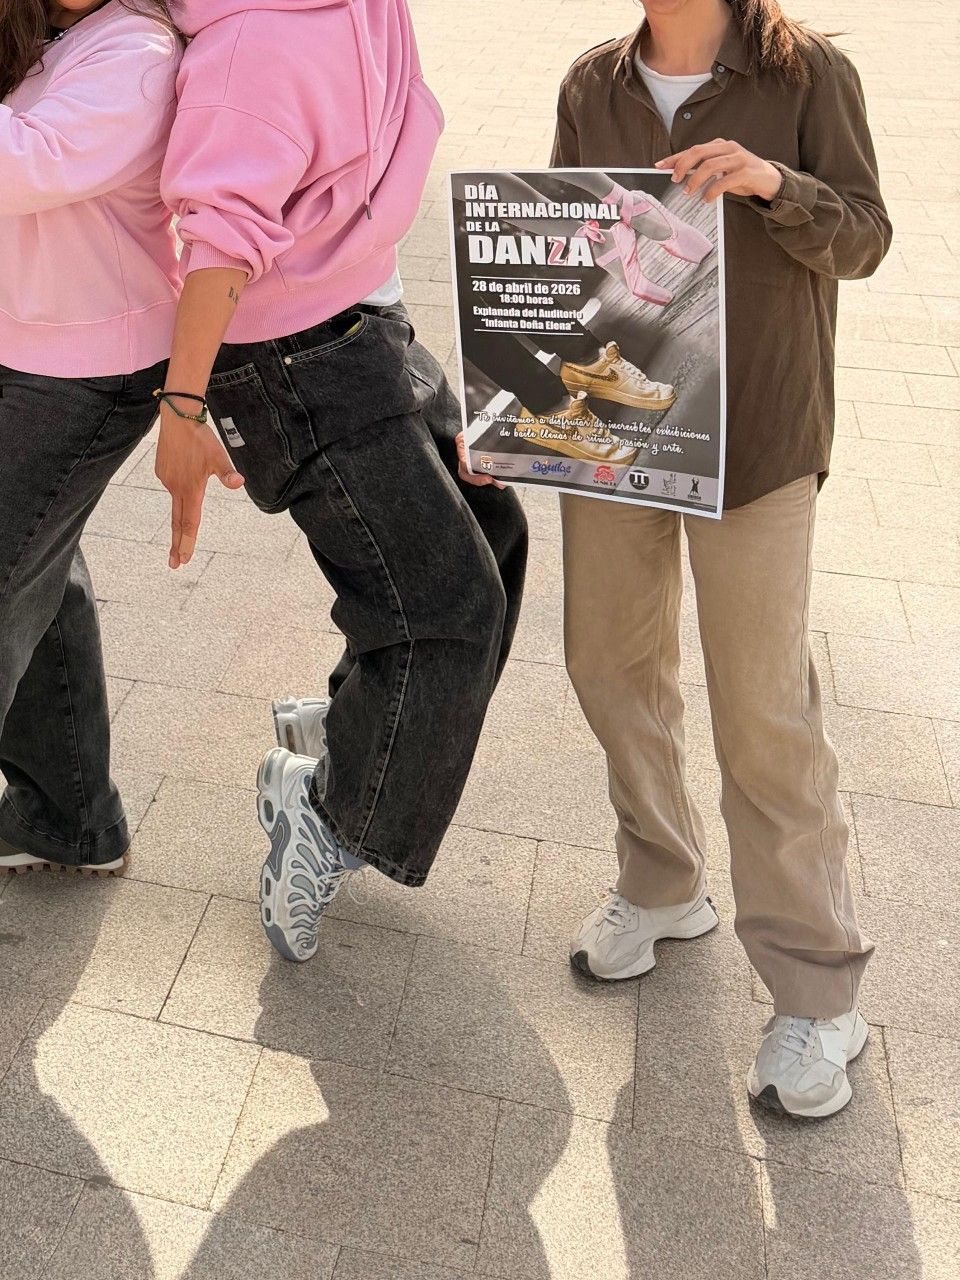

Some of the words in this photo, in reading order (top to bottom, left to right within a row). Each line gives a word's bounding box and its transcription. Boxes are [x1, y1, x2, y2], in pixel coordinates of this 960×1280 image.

[464, 182, 499, 200] DÍA
[465, 202, 621, 220] INTERNACIONAL
[466, 221, 482, 232] DE
[484, 221, 501, 232] LA
[467, 234, 595, 267] DANZA
[471, 280, 487, 292] 28
[488, 281, 503, 293] de
[505, 282, 533, 294] abril
[534, 283, 549, 295] de
[550, 283, 581, 296] 2026
[499, 293, 525, 304] 18:00
[526, 294, 554, 305] horas
[472, 305, 521, 317] Explanada
[521, 307, 537, 318] del
[538, 308, 584, 319] Auditorio
[519, 319, 545, 330] Doña
[651, 444, 660, 456] y
